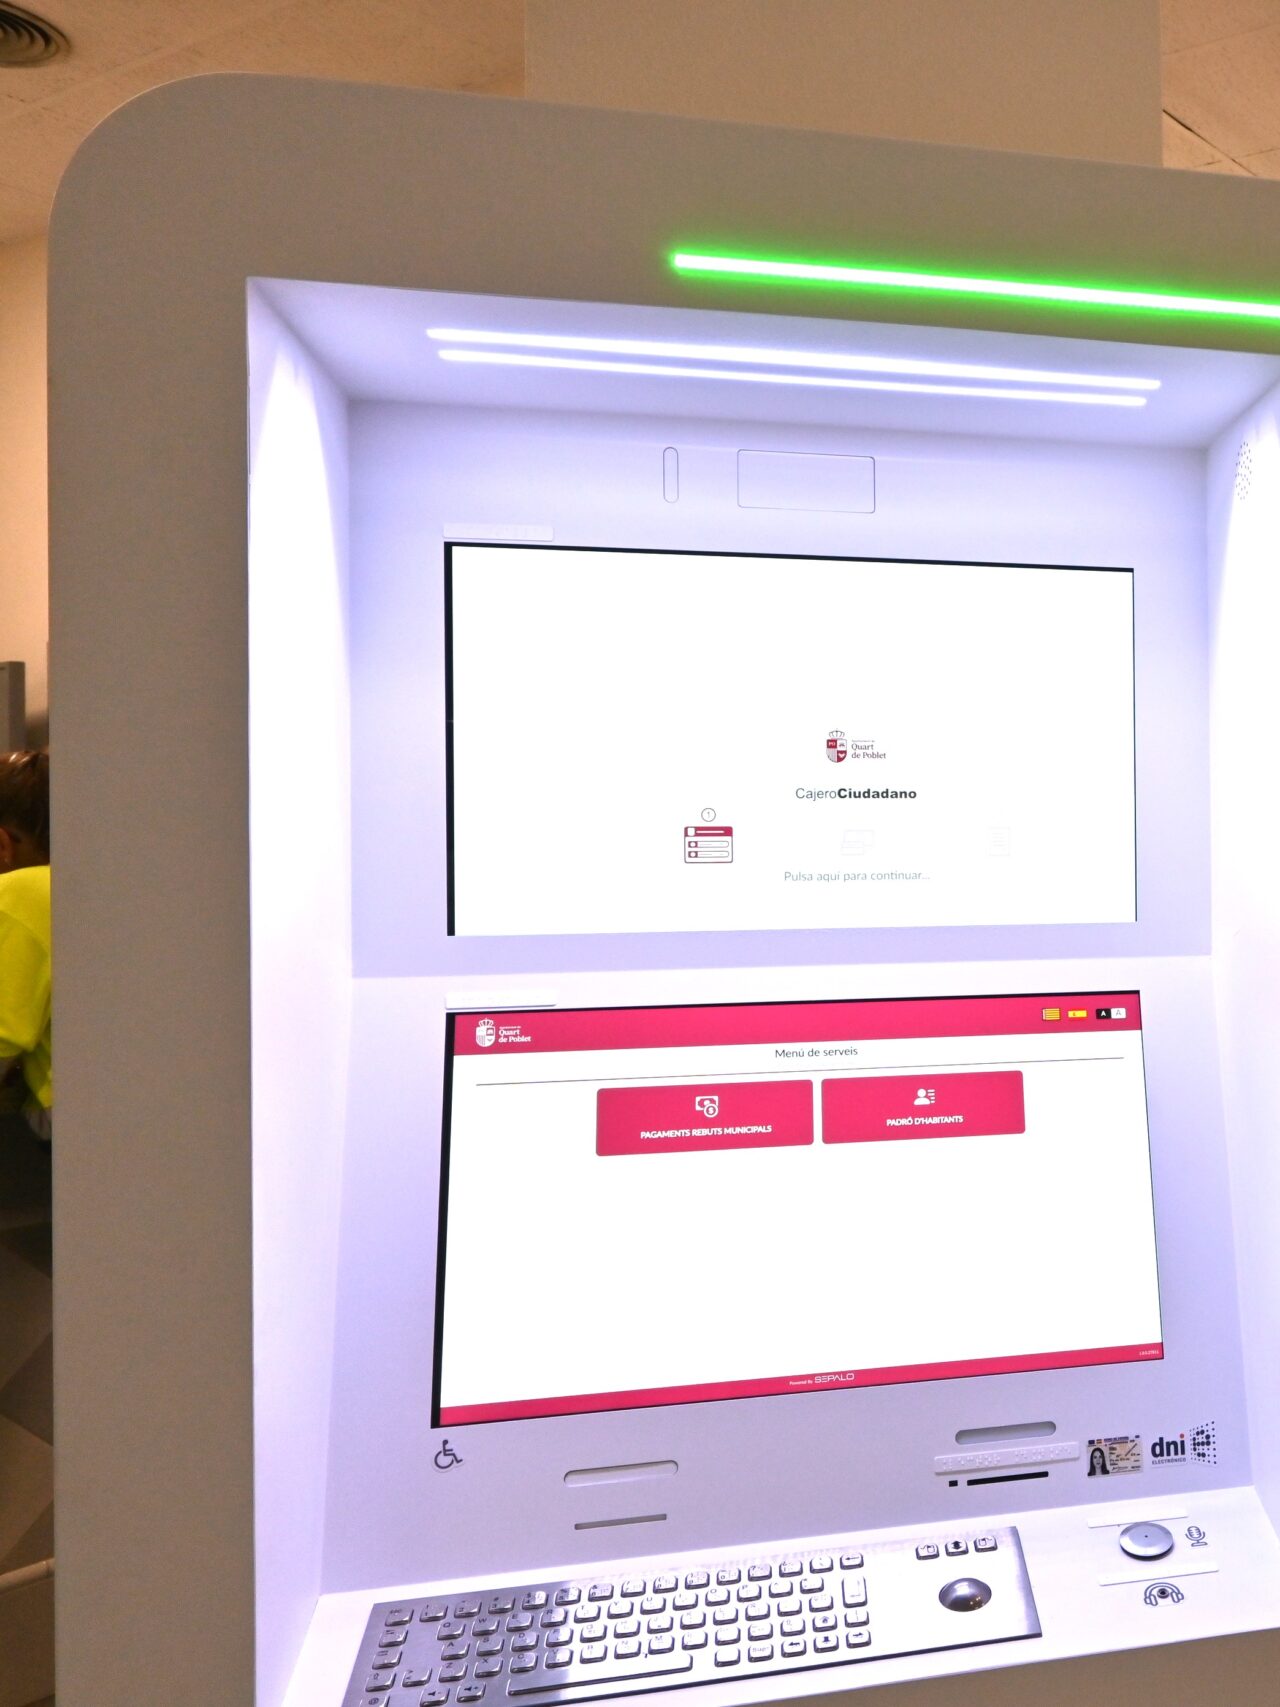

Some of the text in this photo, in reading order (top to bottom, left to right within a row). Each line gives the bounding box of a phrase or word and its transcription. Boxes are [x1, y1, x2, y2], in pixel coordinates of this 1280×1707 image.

[851, 743, 874, 751] Quart
[851, 751, 886, 759] de Poblet
[795, 787, 917, 801] CajeroCiudadano
[784, 871, 813, 882] Pulsa
[843, 872, 867, 883] para
[774, 1046, 859, 1059] Menú de serveis
[886, 1114, 964, 1127] PADRÓ D'HABITANTS
[640, 1125, 772, 1139] PAGAMENTS REBUTS MUNICIPALS
[814, 1373, 855, 1384] SEPALO
[1151, 1433, 1186, 1458] dni
